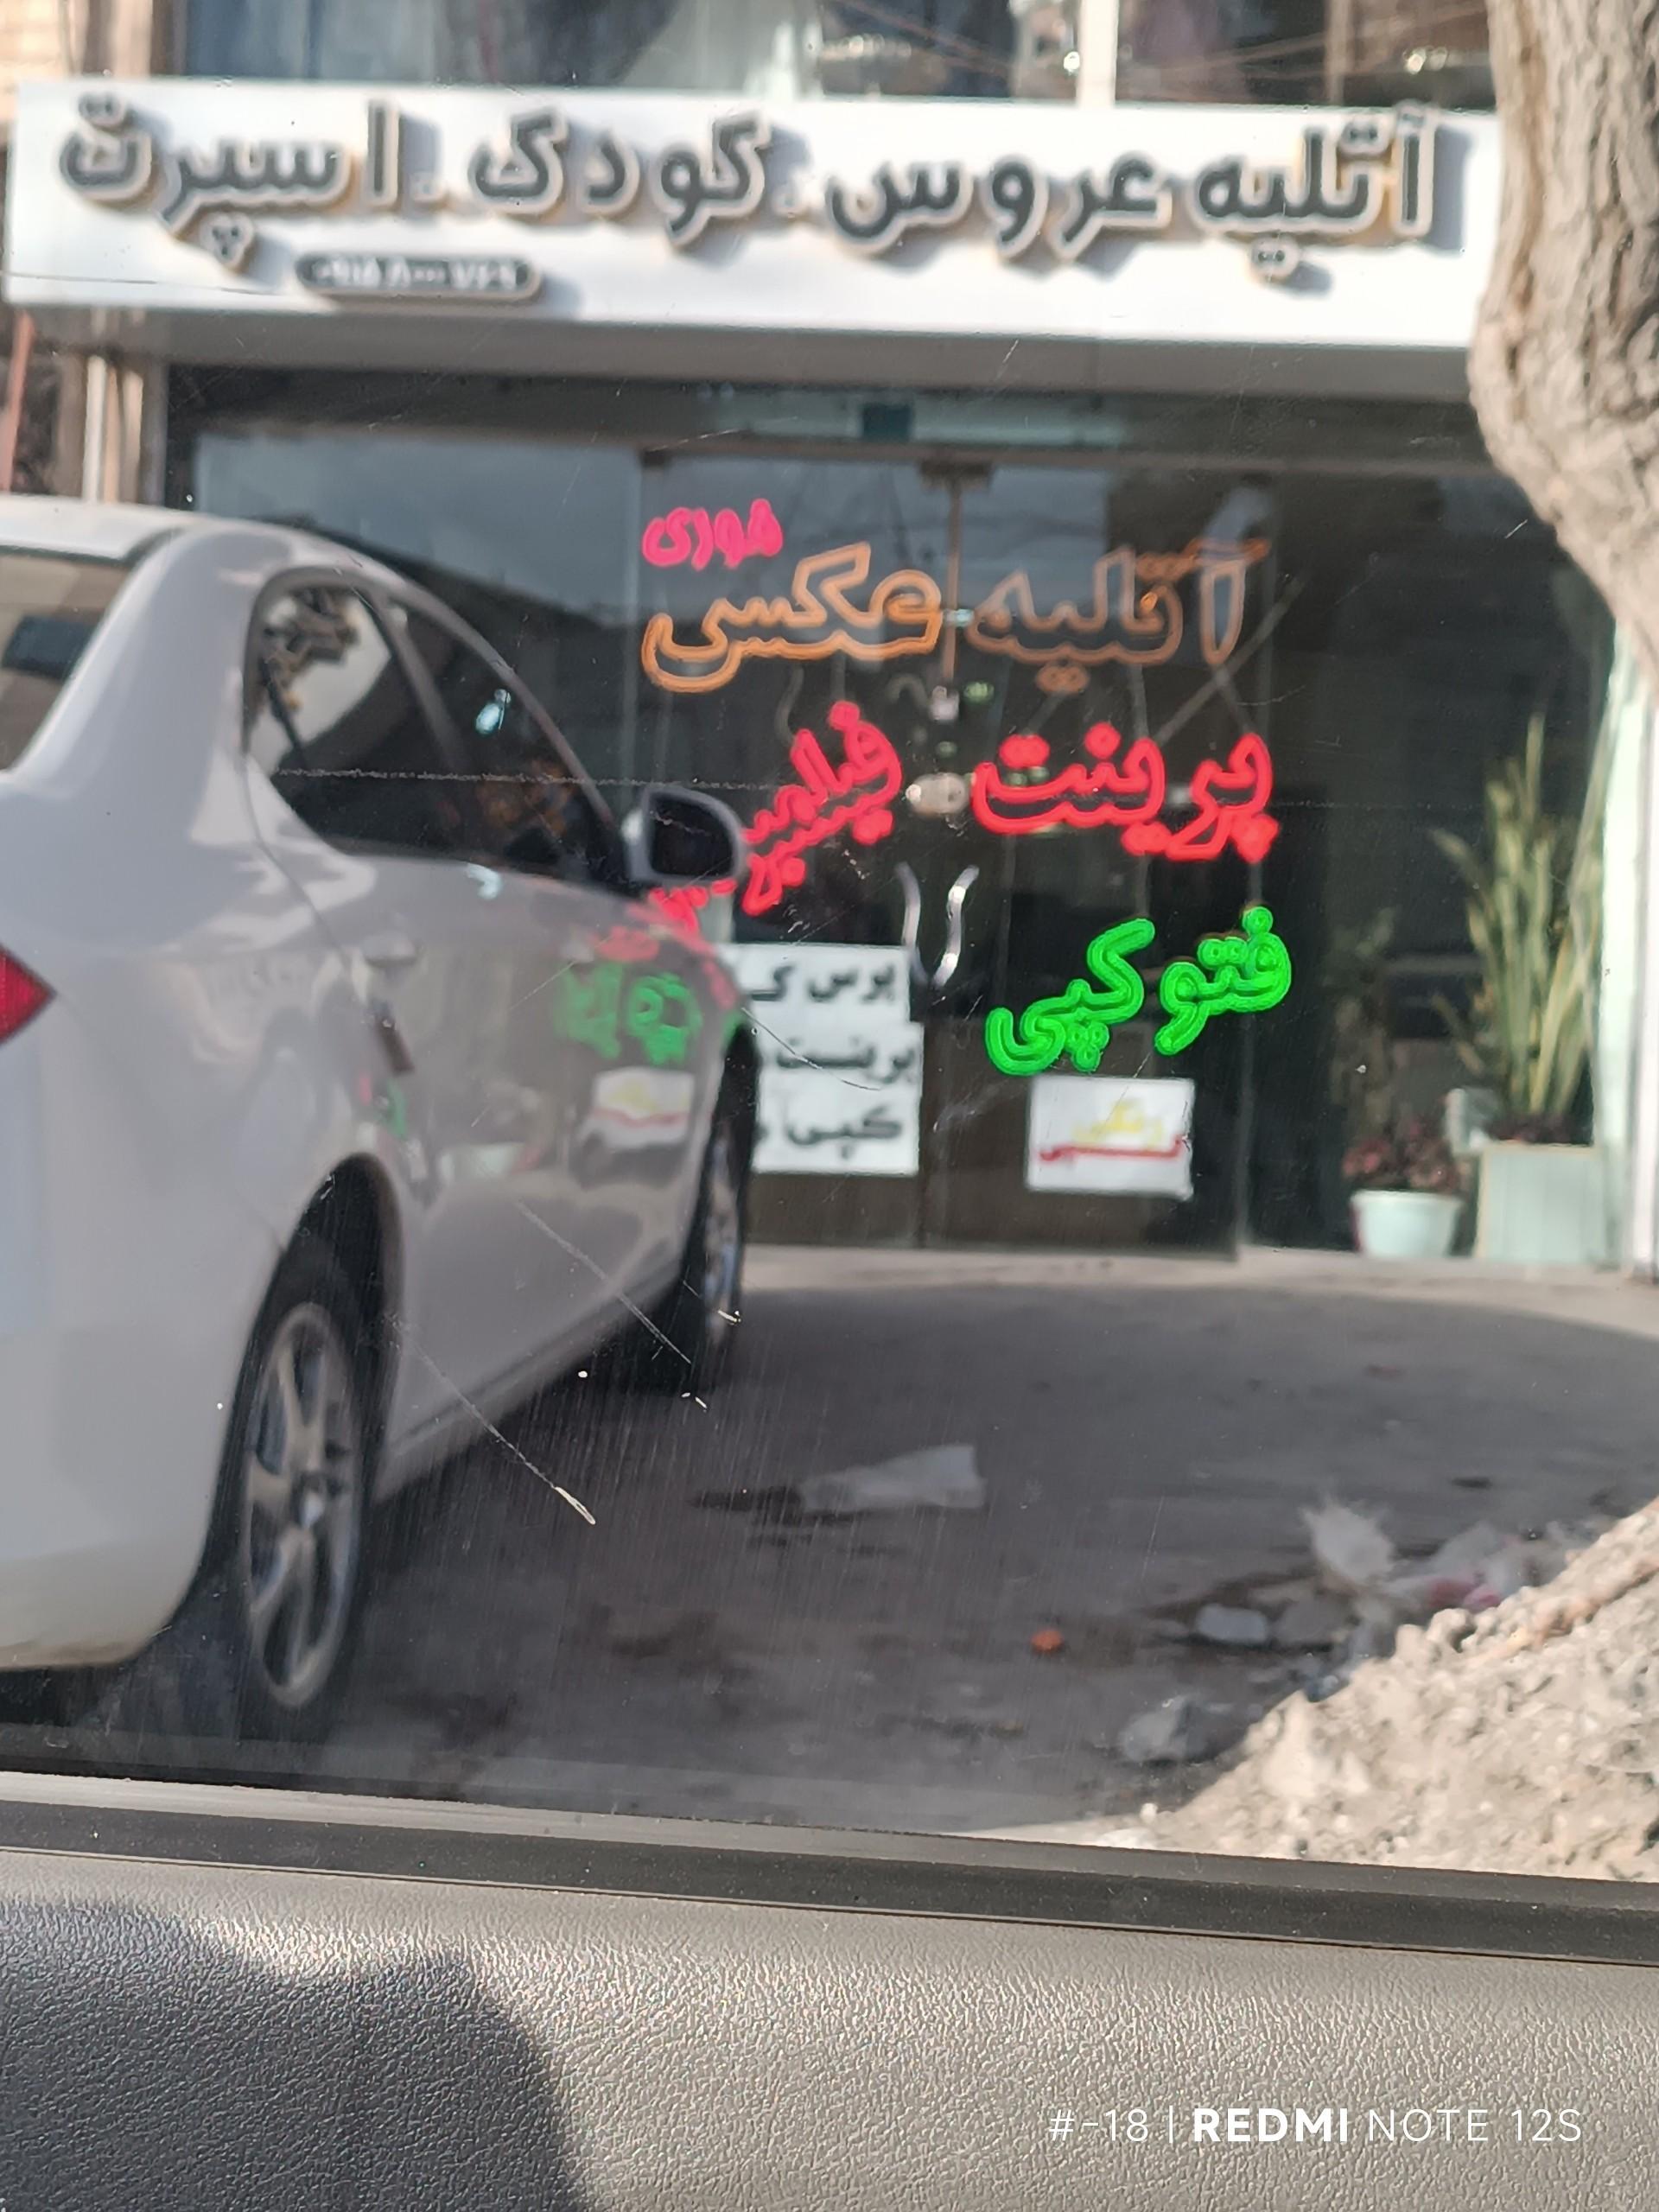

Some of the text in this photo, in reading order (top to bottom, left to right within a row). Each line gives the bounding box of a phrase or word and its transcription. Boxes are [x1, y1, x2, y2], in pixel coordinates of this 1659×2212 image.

[59, 92, 1436, 285] آتلیه عروس کودک اسپرت
[972, 721, 1279, 862] پرینت
[986, 906, 1291, 1076] فتو کپی
